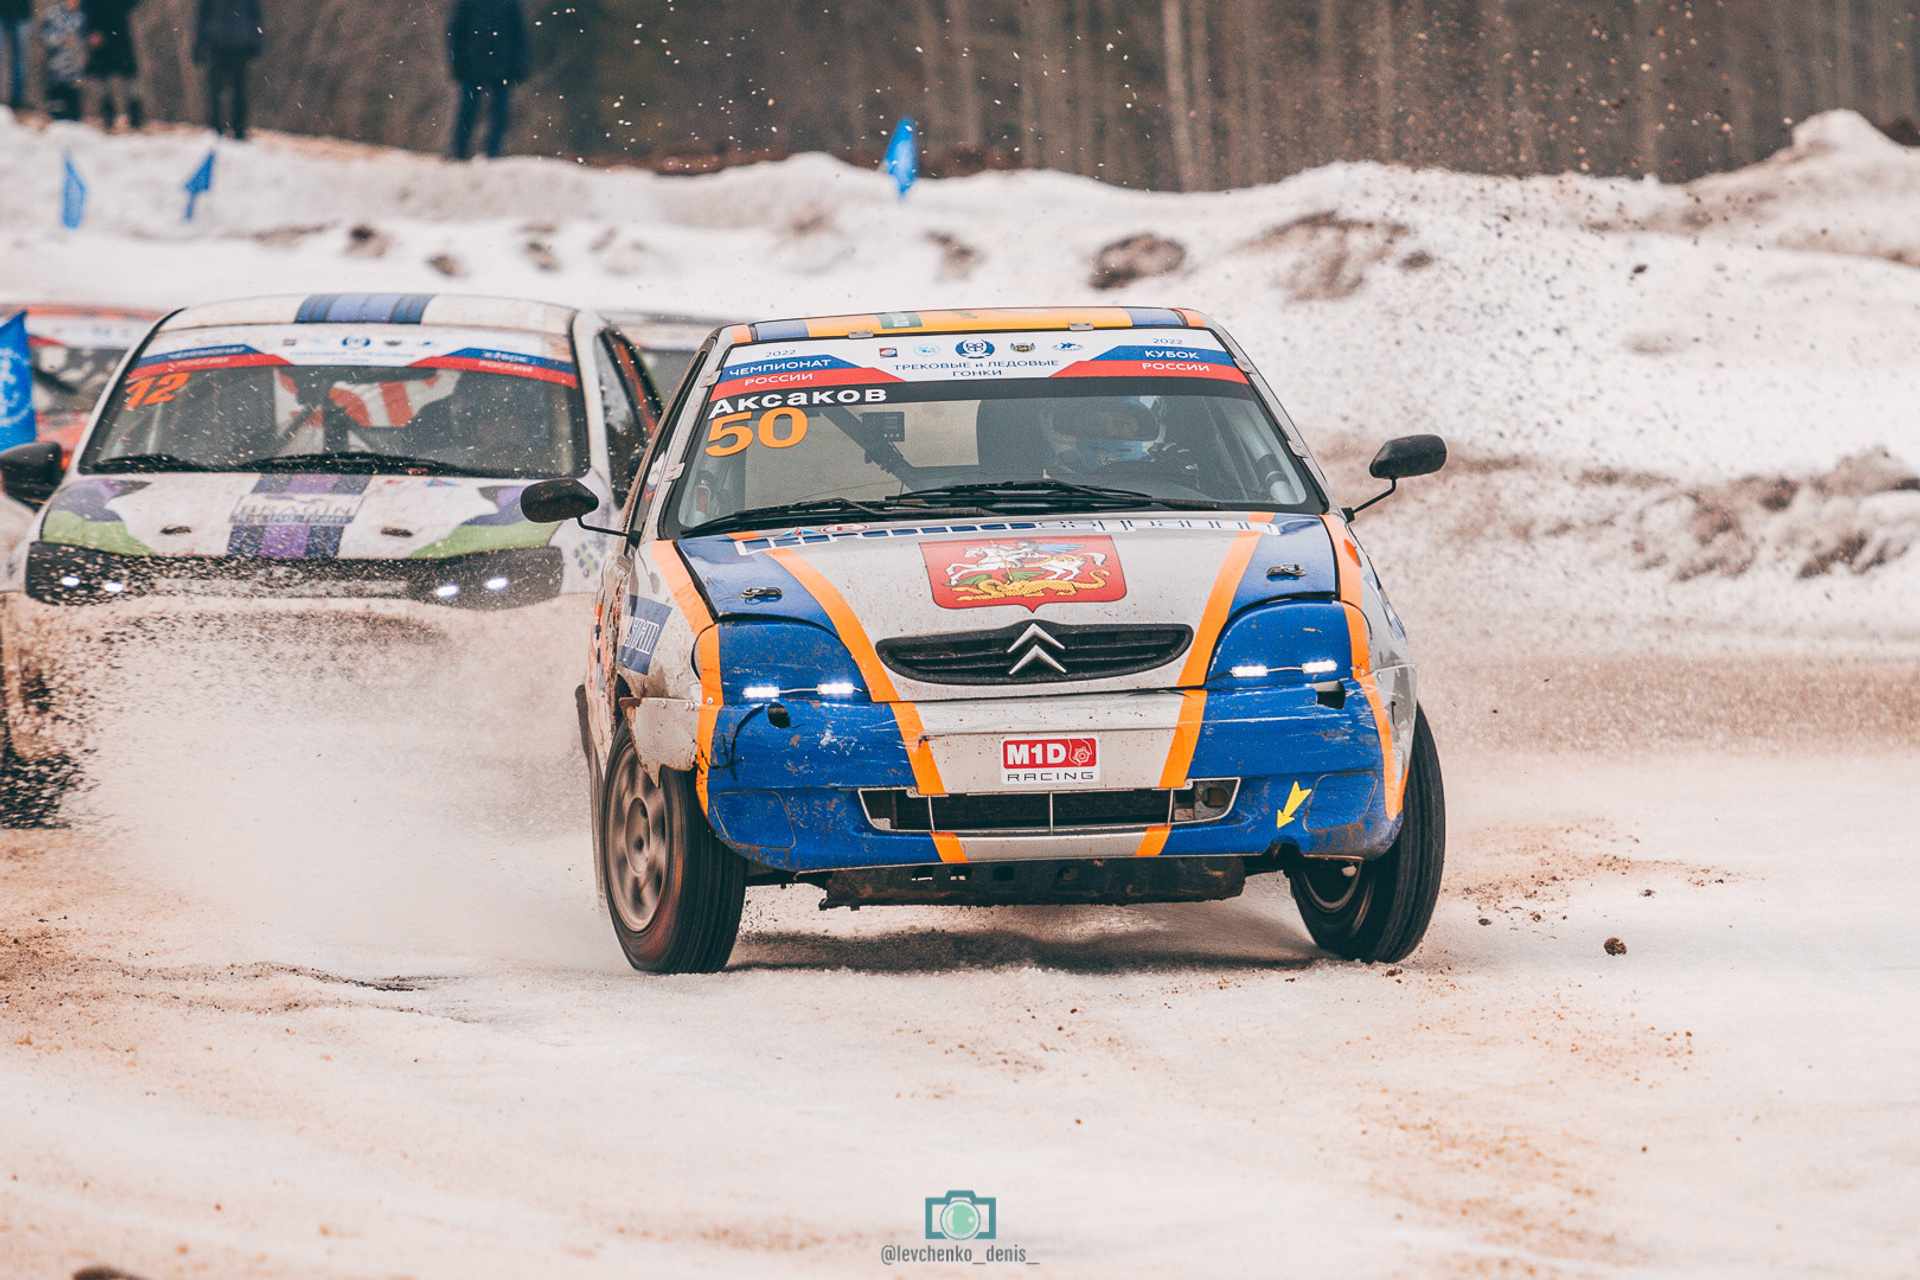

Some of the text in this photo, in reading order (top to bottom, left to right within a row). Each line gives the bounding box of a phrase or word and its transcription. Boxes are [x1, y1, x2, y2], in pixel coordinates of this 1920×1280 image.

[1152, 337, 1183, 345] 2022
[765, 349, 796, 357] 2022
[1144, 349, 1200, 360] КУБОК
[729, 359, 831, 376] ЧЕМПИОНАТ
[893, 361, 971, 371] ТРЕКОВЫЕ
[987, 359, 1060, 368] ЛЕДОВЫЕ
[1141, 362, 1210, 372] РОССИИ
[744, 373, 813, 387] РОССИИ
[124, 372, 191, 410] 12
[707, 388, 887, 420] Аксаков
[705, 406, 808, 457] 50
[1007, 743, 1067, 765] M1D
[1007, 772, 1093, 782] RACING
